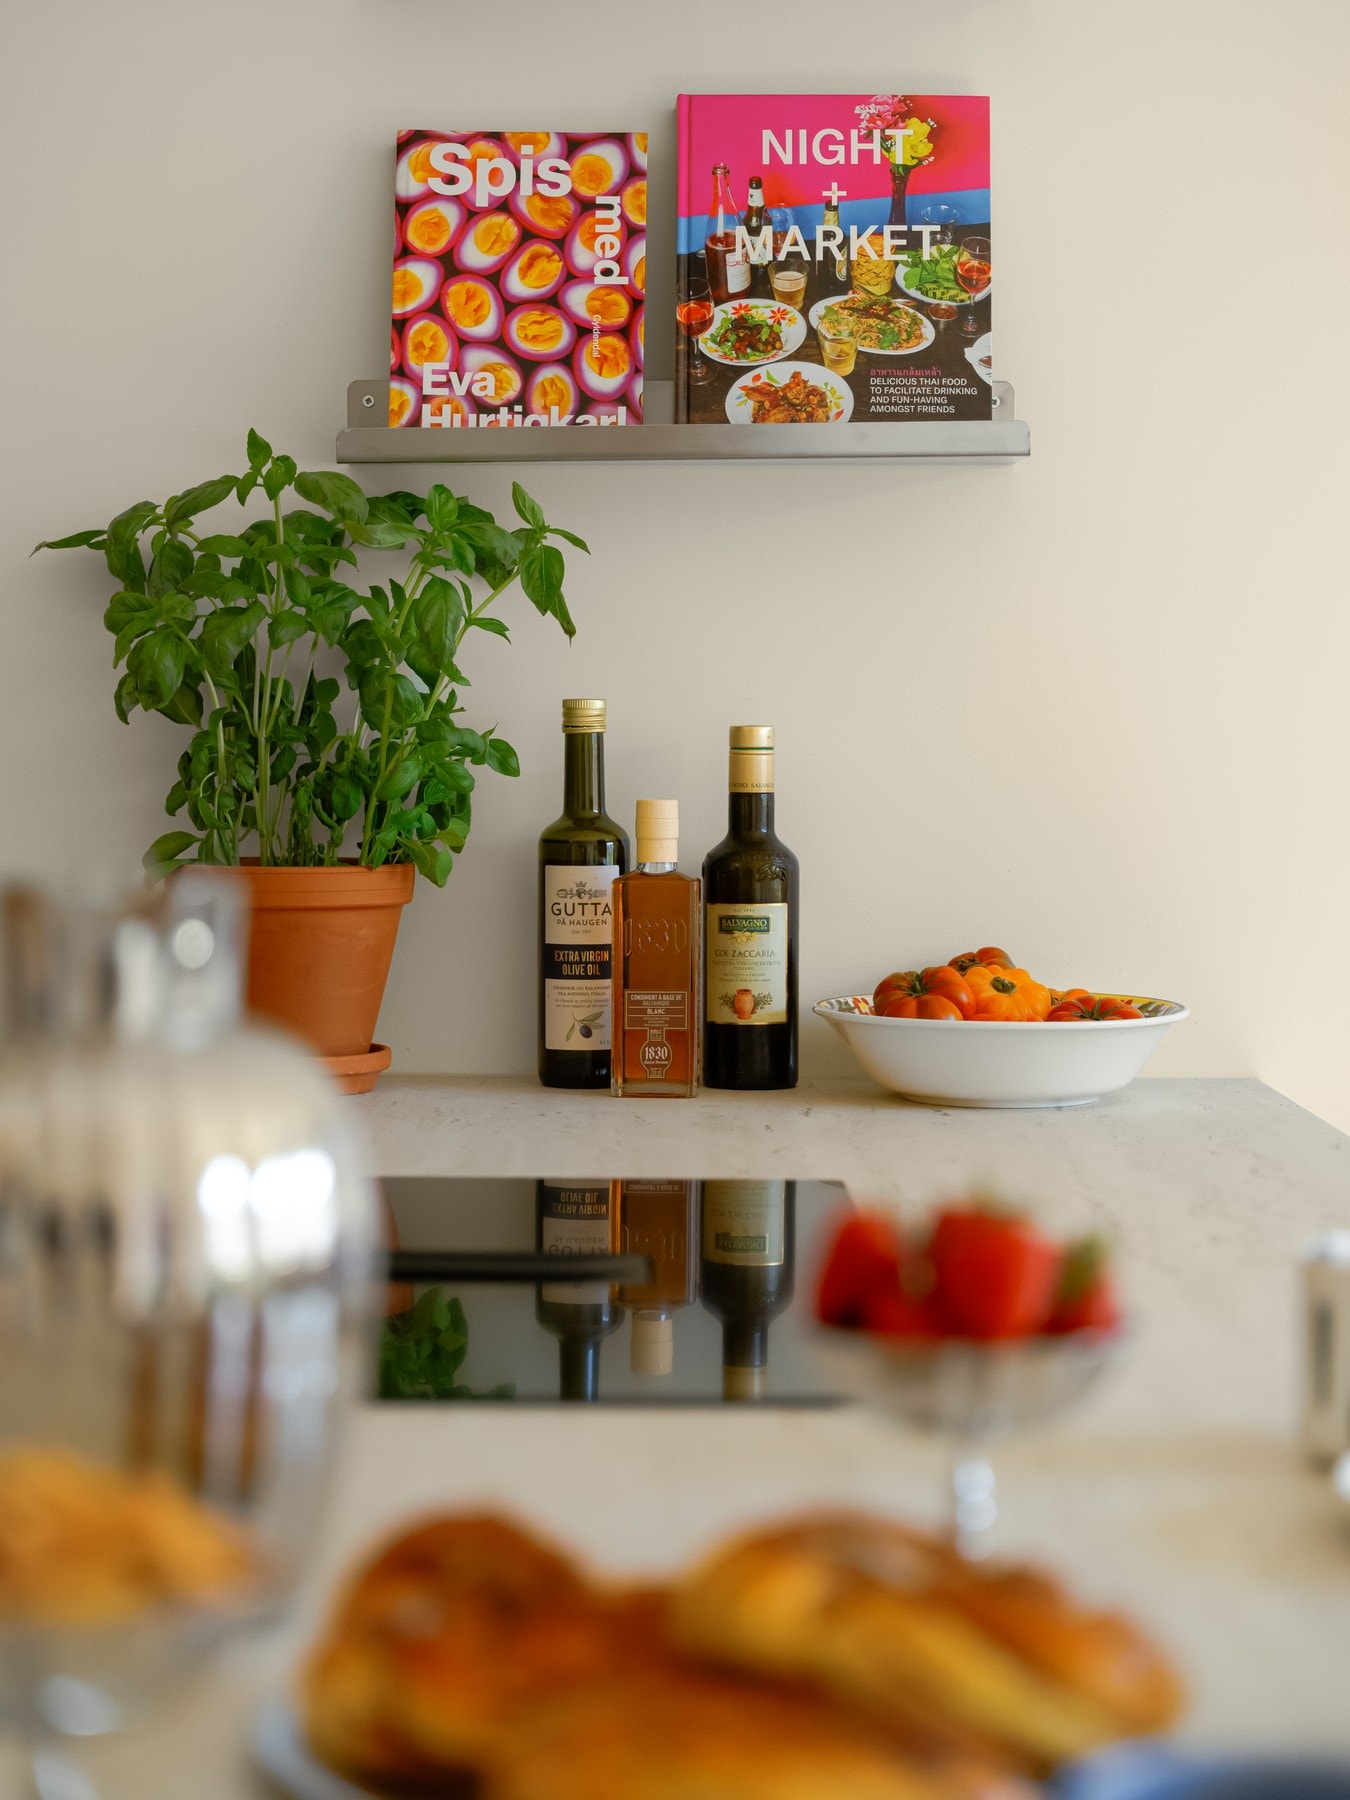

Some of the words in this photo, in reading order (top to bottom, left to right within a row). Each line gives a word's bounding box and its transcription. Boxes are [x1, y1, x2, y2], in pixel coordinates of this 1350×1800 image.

[763, 129, 913, 165] NIGHT
[427, 143, 572, 206] Spis
[594, 196, 628, 284] med
[735, 225, 941, 260] MARKET
[592, 315, 601, 357] Gyldendal
[423, 362, 495, 396] Eva
[551, 902, 612, 916] GUTTA
[555, 951, 579, 961] EXTRA
[581, 951, 608, 961] VIRGIN
[563, 964, 585, 975] OLIVE
[588, 964, 600, 975] OIL
[645, 1047, 667, 1060] 1830
